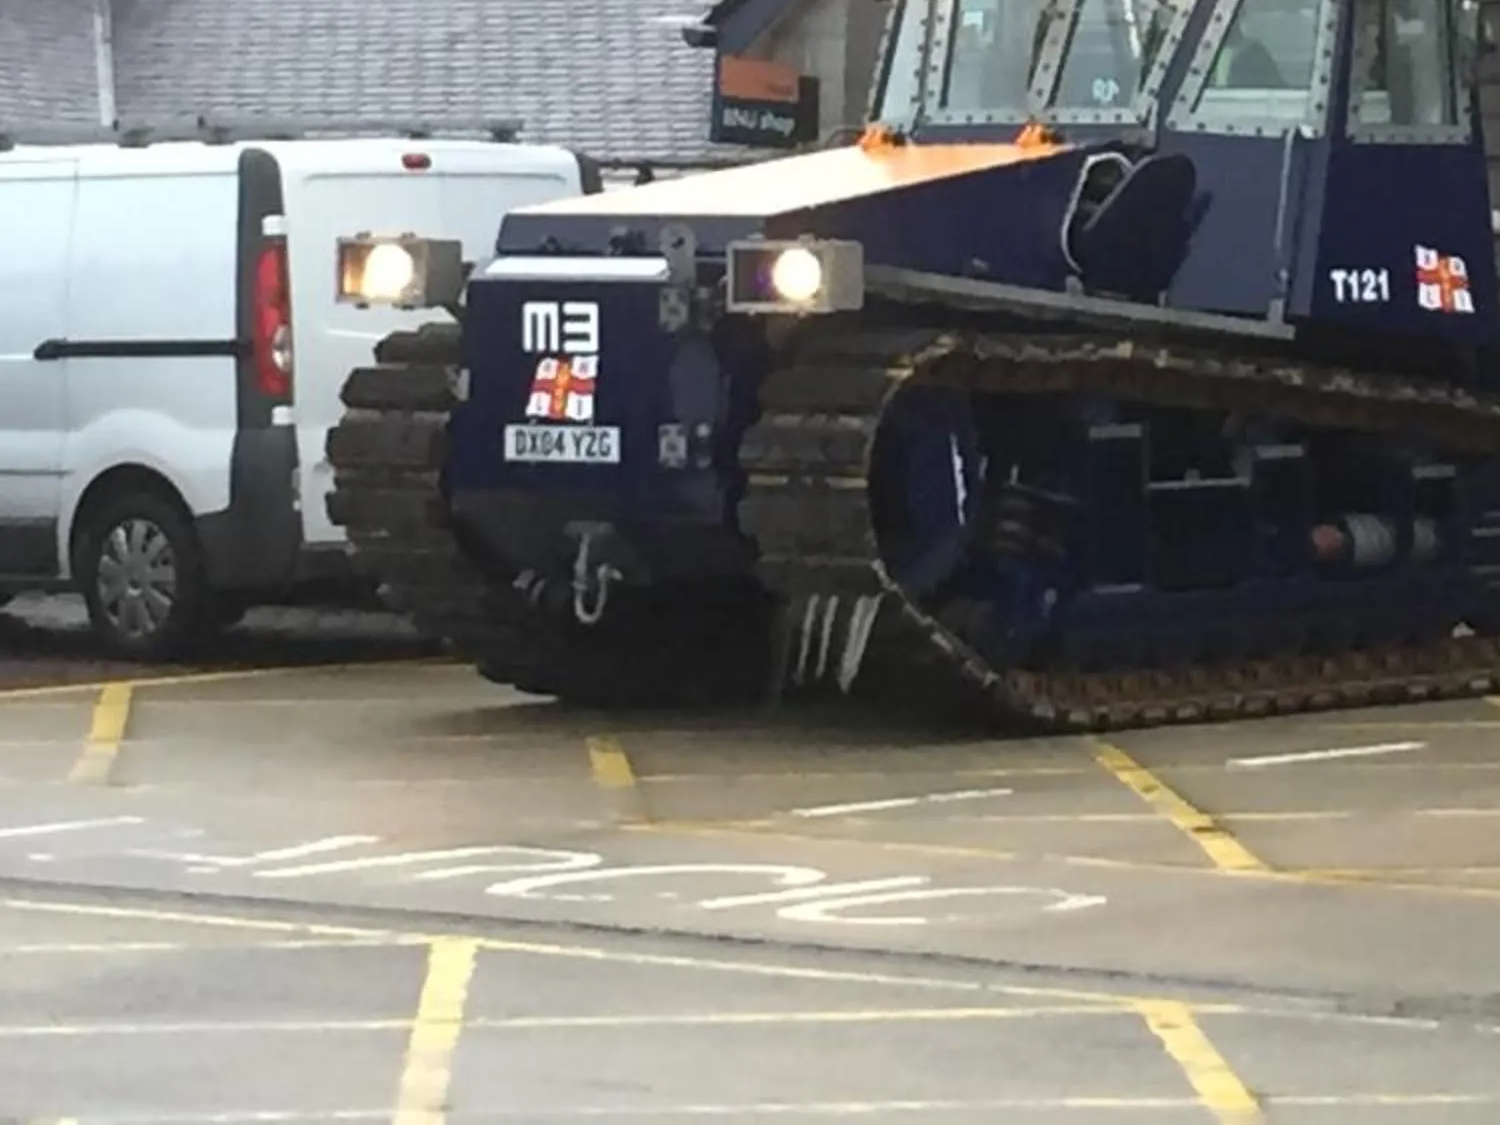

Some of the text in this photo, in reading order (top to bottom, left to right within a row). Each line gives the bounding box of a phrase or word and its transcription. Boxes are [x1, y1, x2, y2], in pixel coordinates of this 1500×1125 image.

[1329, 267, 1391, 303] T121
[522, 301, 600, 353] M3
[515, 430, 612, 458] DX04 YZG
